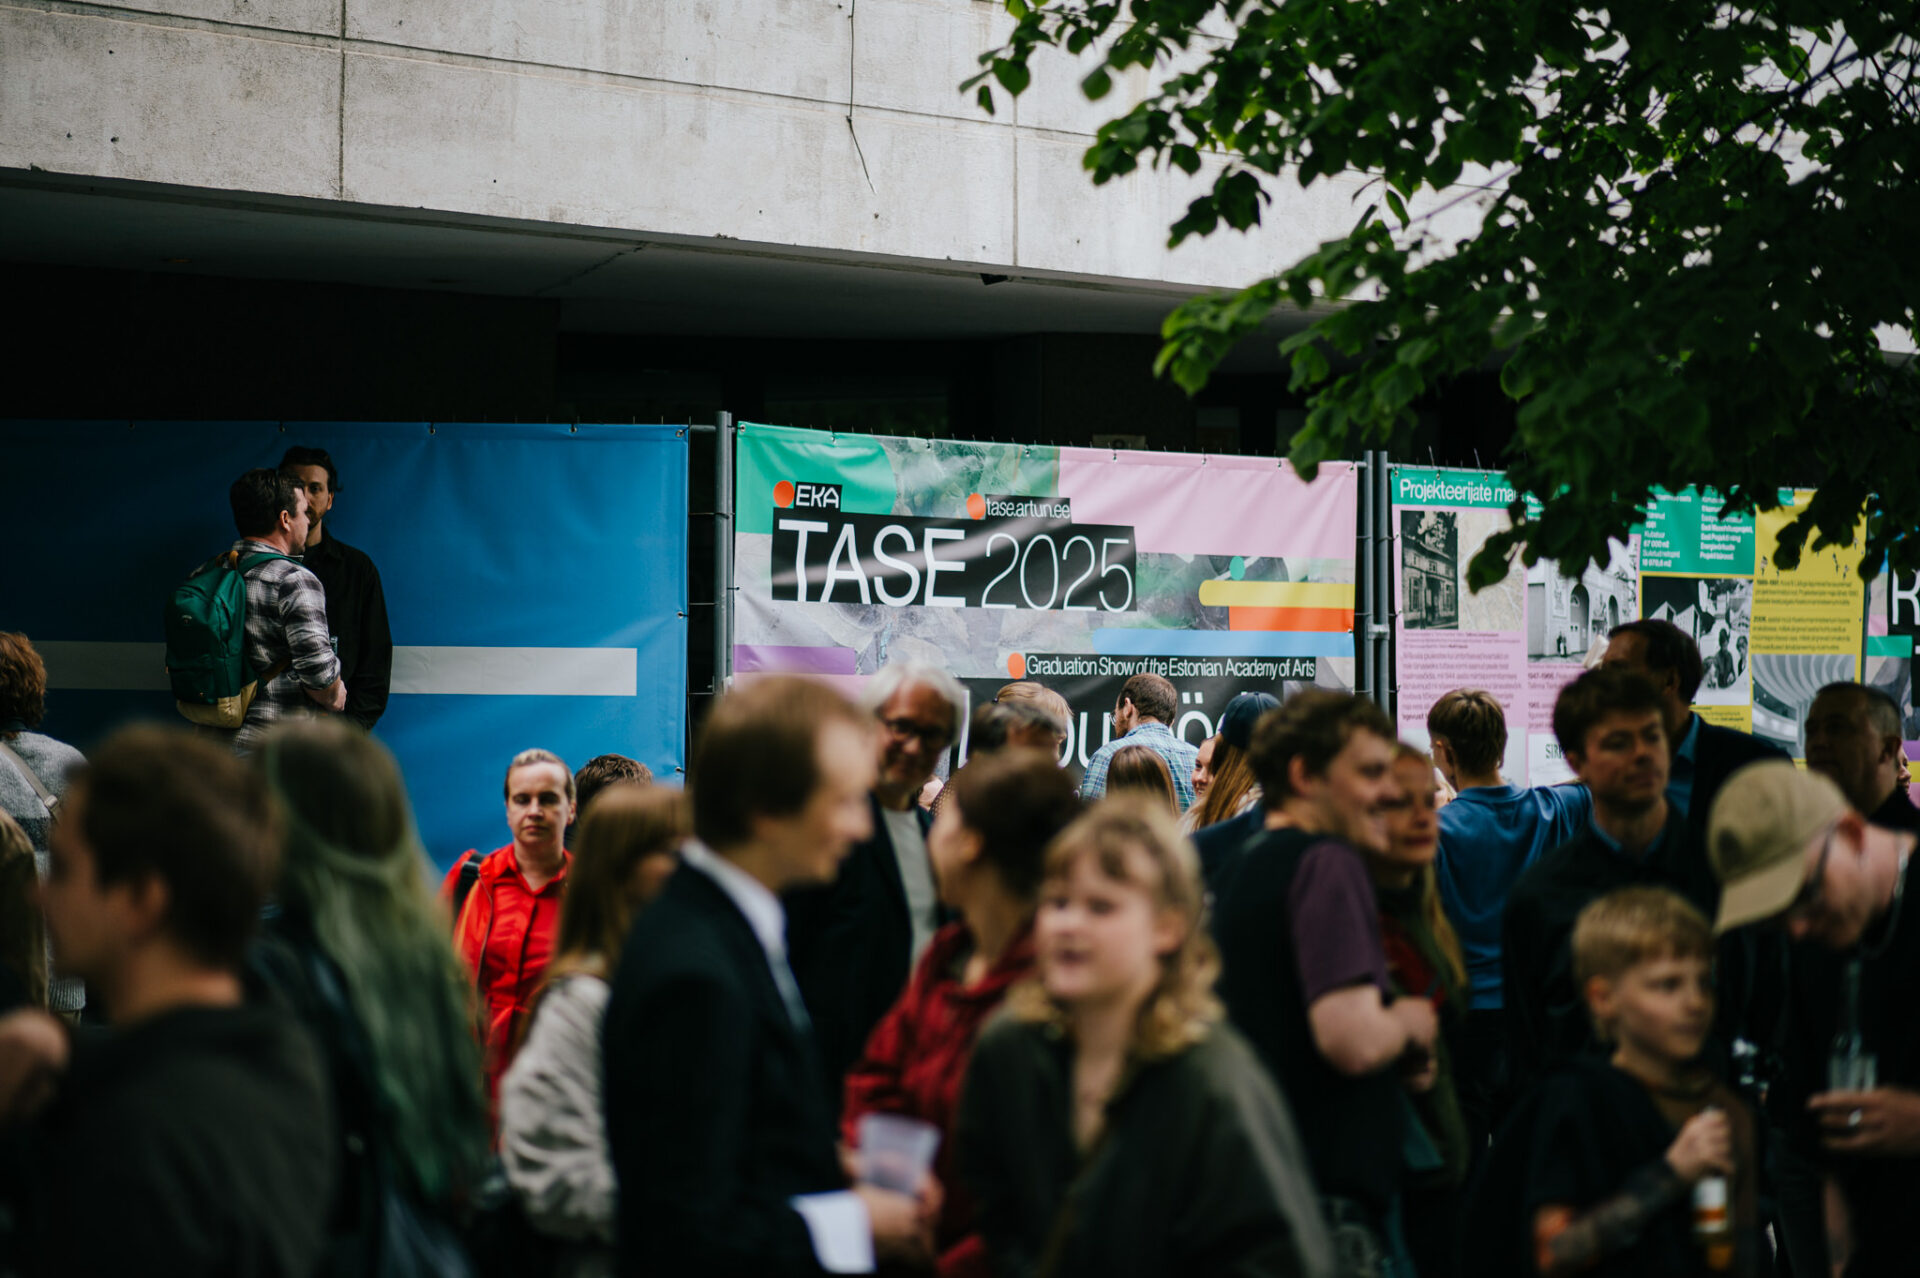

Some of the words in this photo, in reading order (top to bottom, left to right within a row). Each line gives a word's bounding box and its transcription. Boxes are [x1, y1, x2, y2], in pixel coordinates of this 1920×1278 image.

[795, 484, 841, 509] EKA
[1400, 478, 1492, 504] Projekteerijate
[985, 497, 1071, 521] tase.artun.ee
[778, 518, 967, 608] TASE
[980, 532, 1134, 614] 2025
[1026, 655, 1098, 676] Graduation
[1098, 656, 1136, 676] Show
[1136, 657, 1150, 675] of
[1149, 658, 1168, 677] the
[1168, 657, 1224, 678] Estonian
[1224, 657, 1279, 681] Academy
[1278, 658, 1291, 678] of
[1291, 658, 1316, 678] Arts
